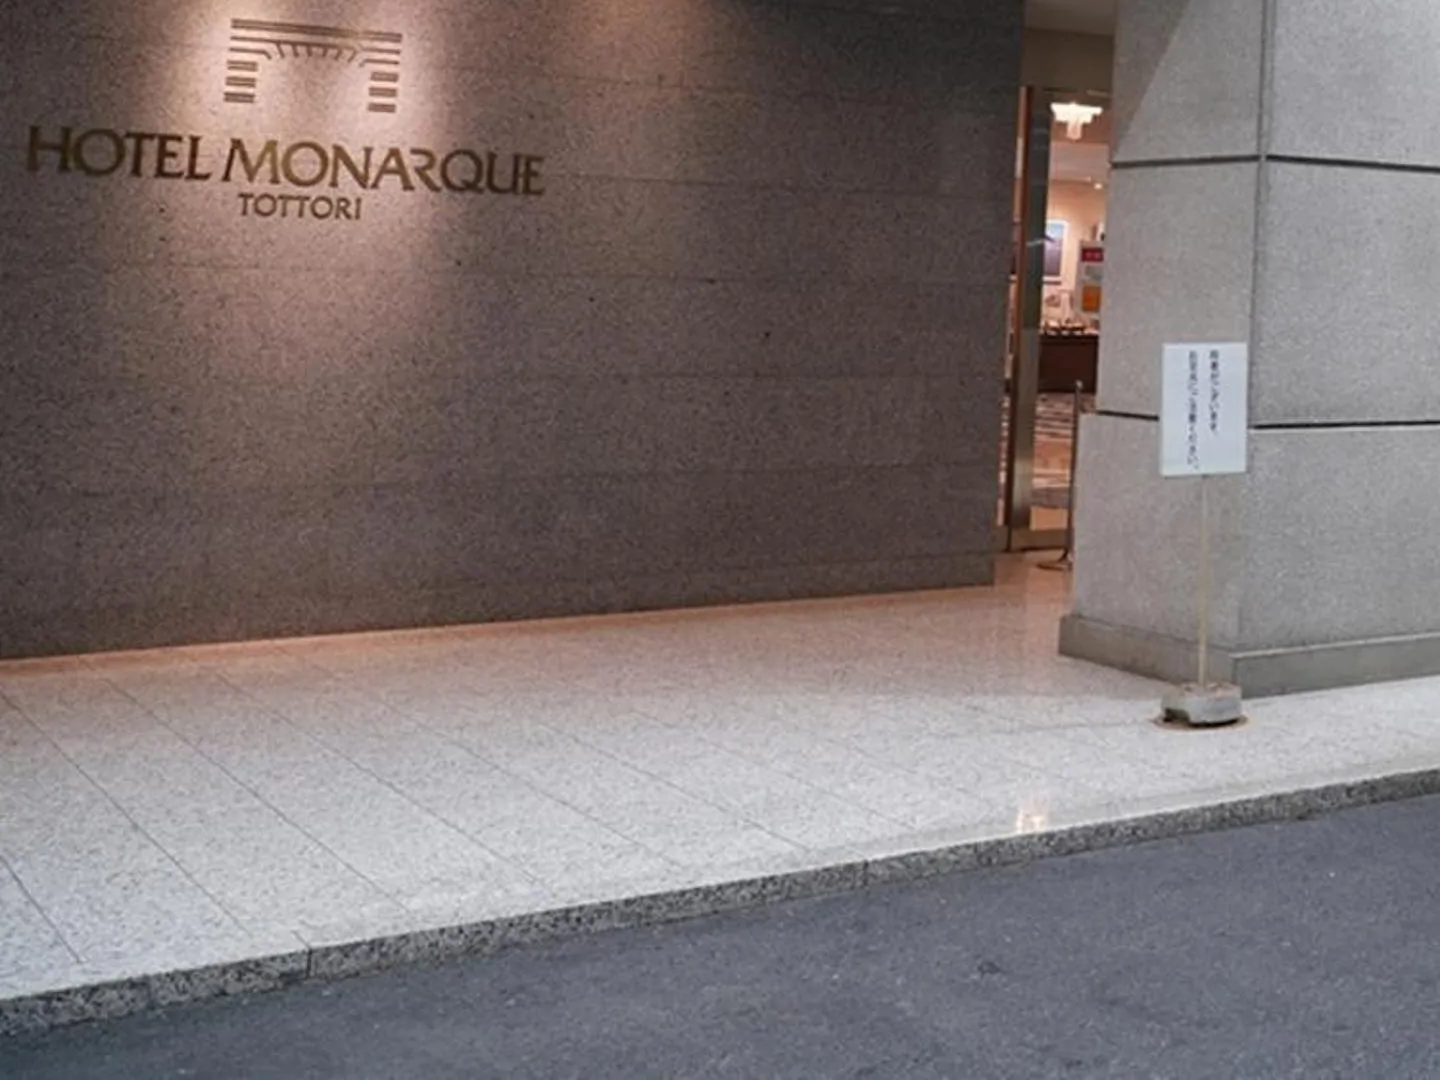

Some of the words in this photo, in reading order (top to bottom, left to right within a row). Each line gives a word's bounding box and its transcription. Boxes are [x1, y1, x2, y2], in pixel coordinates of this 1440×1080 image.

[28, 126, 210, 180] HOTEL
[223, 138, 546, 197] MONARQUE
[238, 193, 362, 220] TOTTORI
